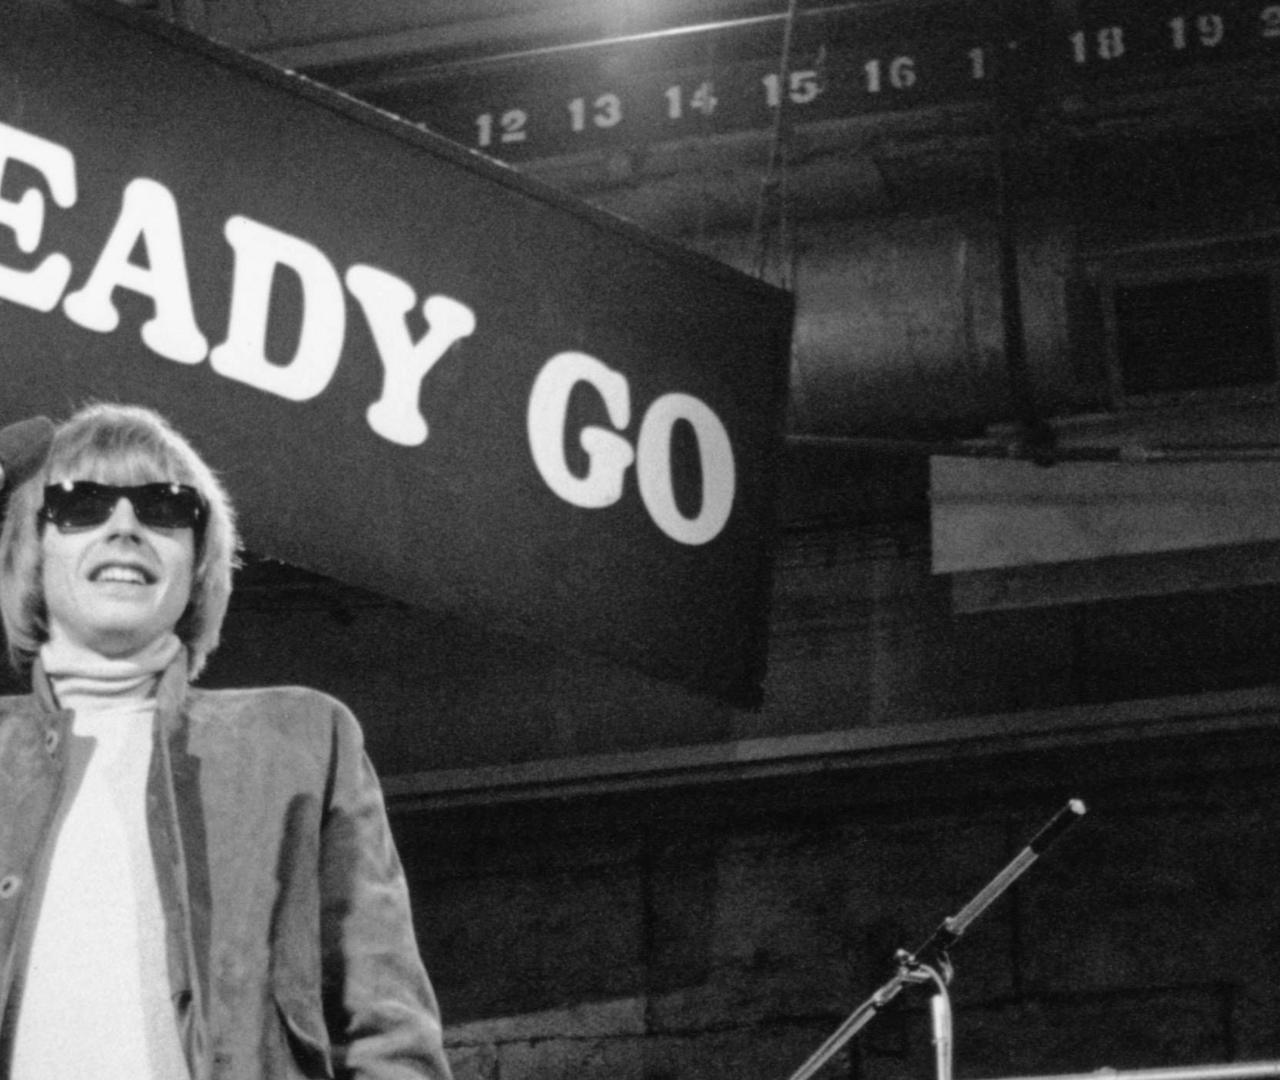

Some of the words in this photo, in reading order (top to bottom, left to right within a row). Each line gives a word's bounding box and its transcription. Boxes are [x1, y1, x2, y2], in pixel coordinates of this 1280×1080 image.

[474, 108, 529, 147] 12
[567, 92, 624, 132] 13
[664, 81, 719, 120] 14
[761, 69, 820, 107] 15
[863, 55, 917, 93] 16
[1067, 25, 1126, 64] 18
[1167, 13, 1225, 50] 19
[526, 350, 736, 546] GO
